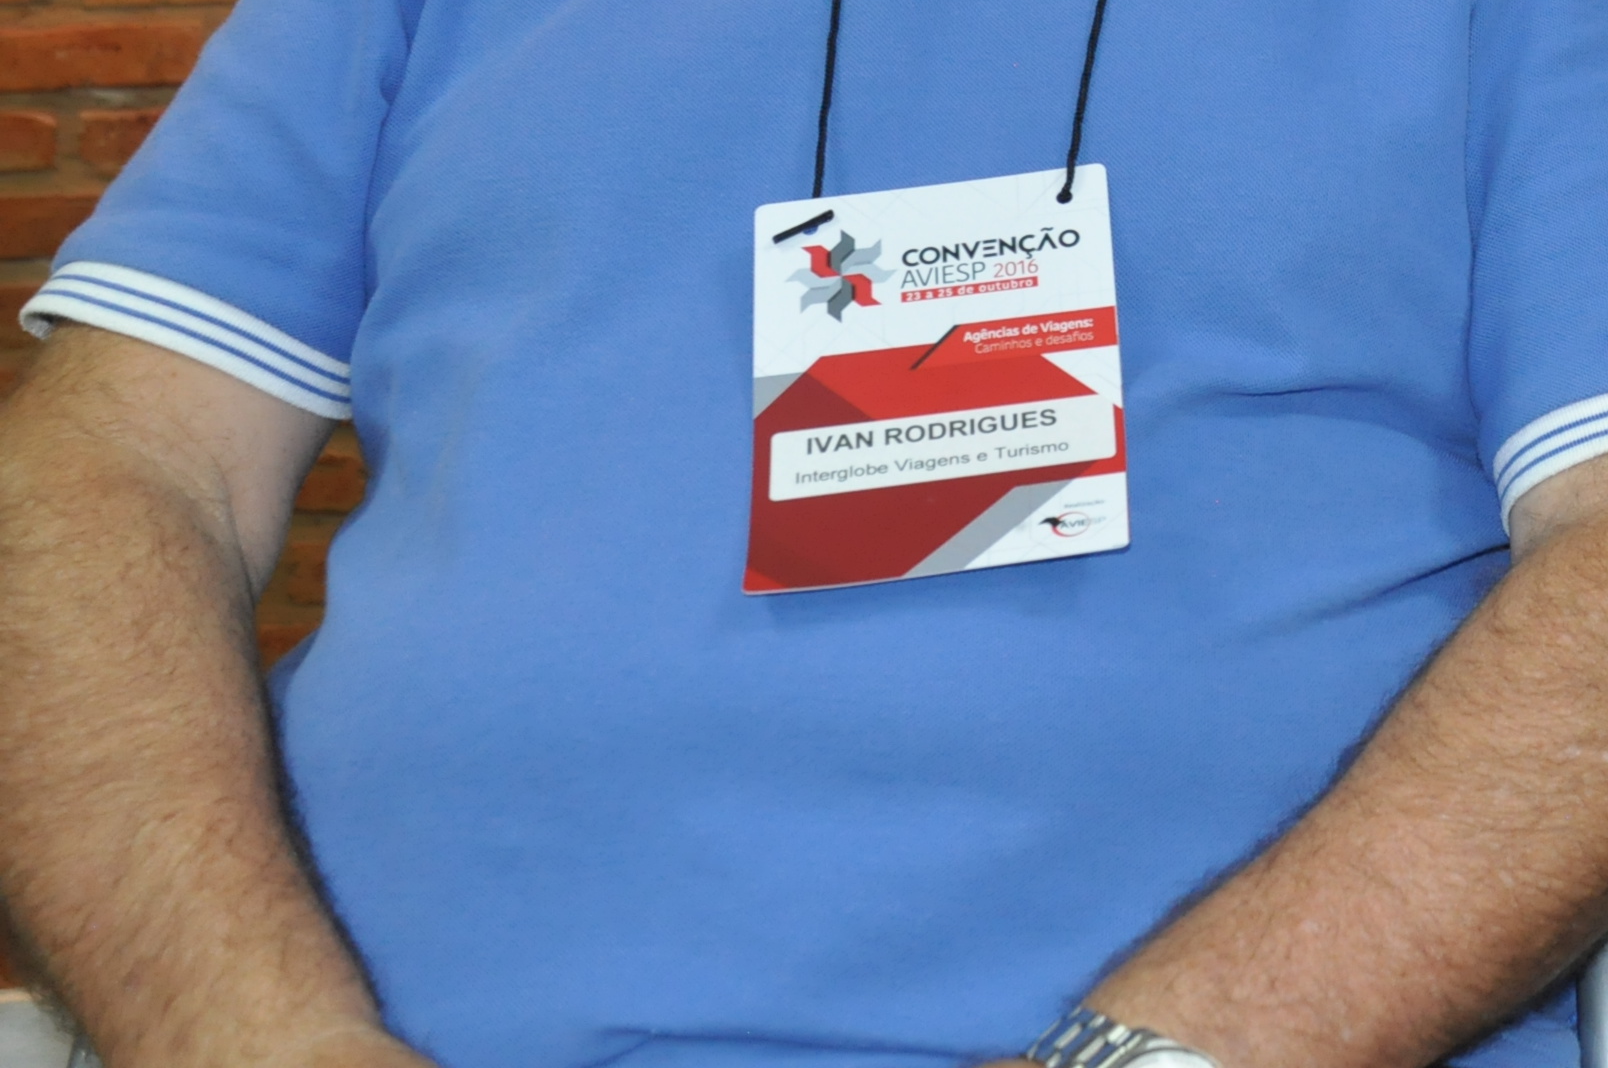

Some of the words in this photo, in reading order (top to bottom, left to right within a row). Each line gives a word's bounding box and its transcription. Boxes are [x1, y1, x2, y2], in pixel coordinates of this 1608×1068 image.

[902, 227, 1080, 267] CONVENÇÃO
[901, 261, 986, 289] AVIESP
[993, 259, 1039, 278] 2016
[906, 291, 921, 302] 23
[925, 290, 934, 300] a
[938, 287, 953, 298] 25
[957, 285, 973, 296] de
[978, 278, 1033, 293] outubro
[963, 326, 1020, 343] Agências
[1022, 323, 1038, 335] de
[1040, 318, 1094, 333] Viagens:
[975, 338, 1032, 354] Caminhos
[1035, 337, 1043, 346] e
[1046, 331, 1094, 345] desafios
[806, 431, 874, 455] IVAN
[884, 409, 1057, 445] RODRIGUES
[795, 461, 888, 485] Interglobe
[894, 451, 970, 472] Viagens
[976, 451, 988, 462] e
[995, 440, 1069, 459] Turismo
